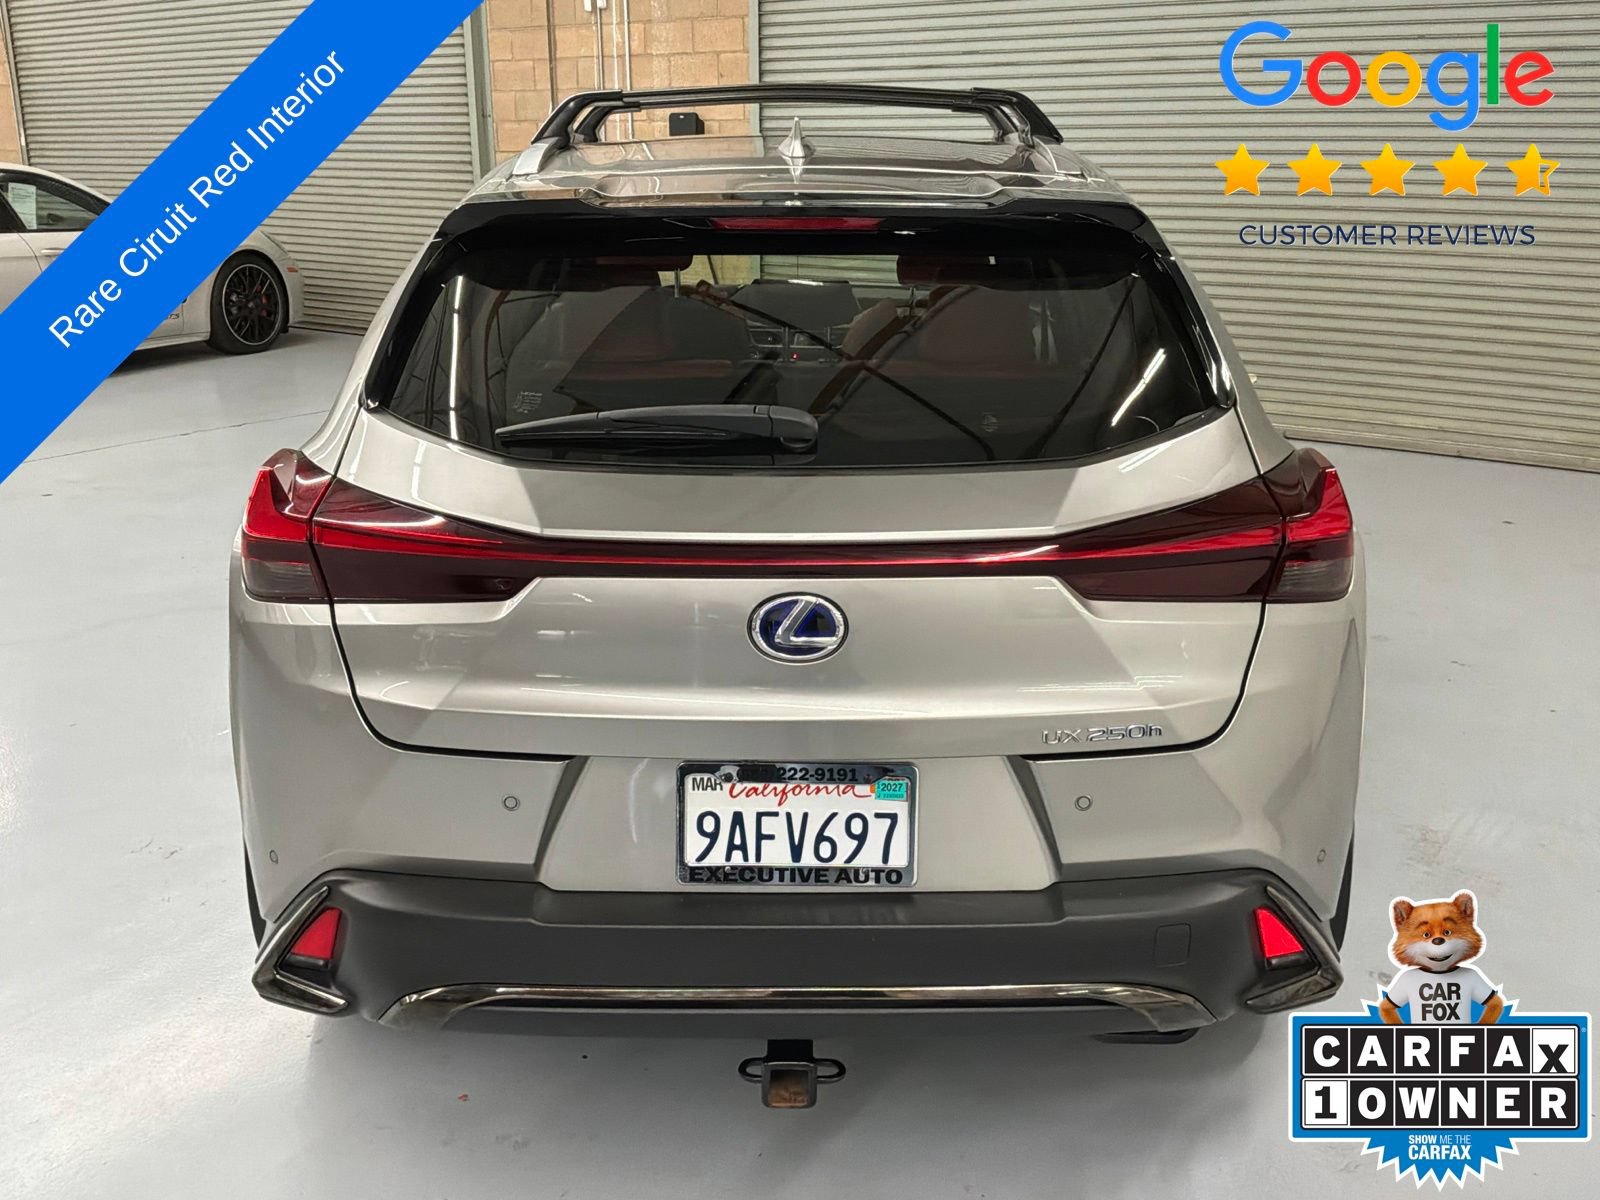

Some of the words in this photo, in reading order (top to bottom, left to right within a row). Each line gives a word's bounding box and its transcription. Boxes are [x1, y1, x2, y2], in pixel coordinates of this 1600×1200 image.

[1042, 728, 1082, 745] UX
[1086, 724, 1163, 742] 250h
[692, 778, 723, 792] MAR
[880, 782, 904, 793] 2027
[728, 783, 872, 807] California
[695, 810, 899, 865] 9AFV697
[689, 867, 829, 884] EXECUTIVE
[834, 868, 903, 885] AUTO
